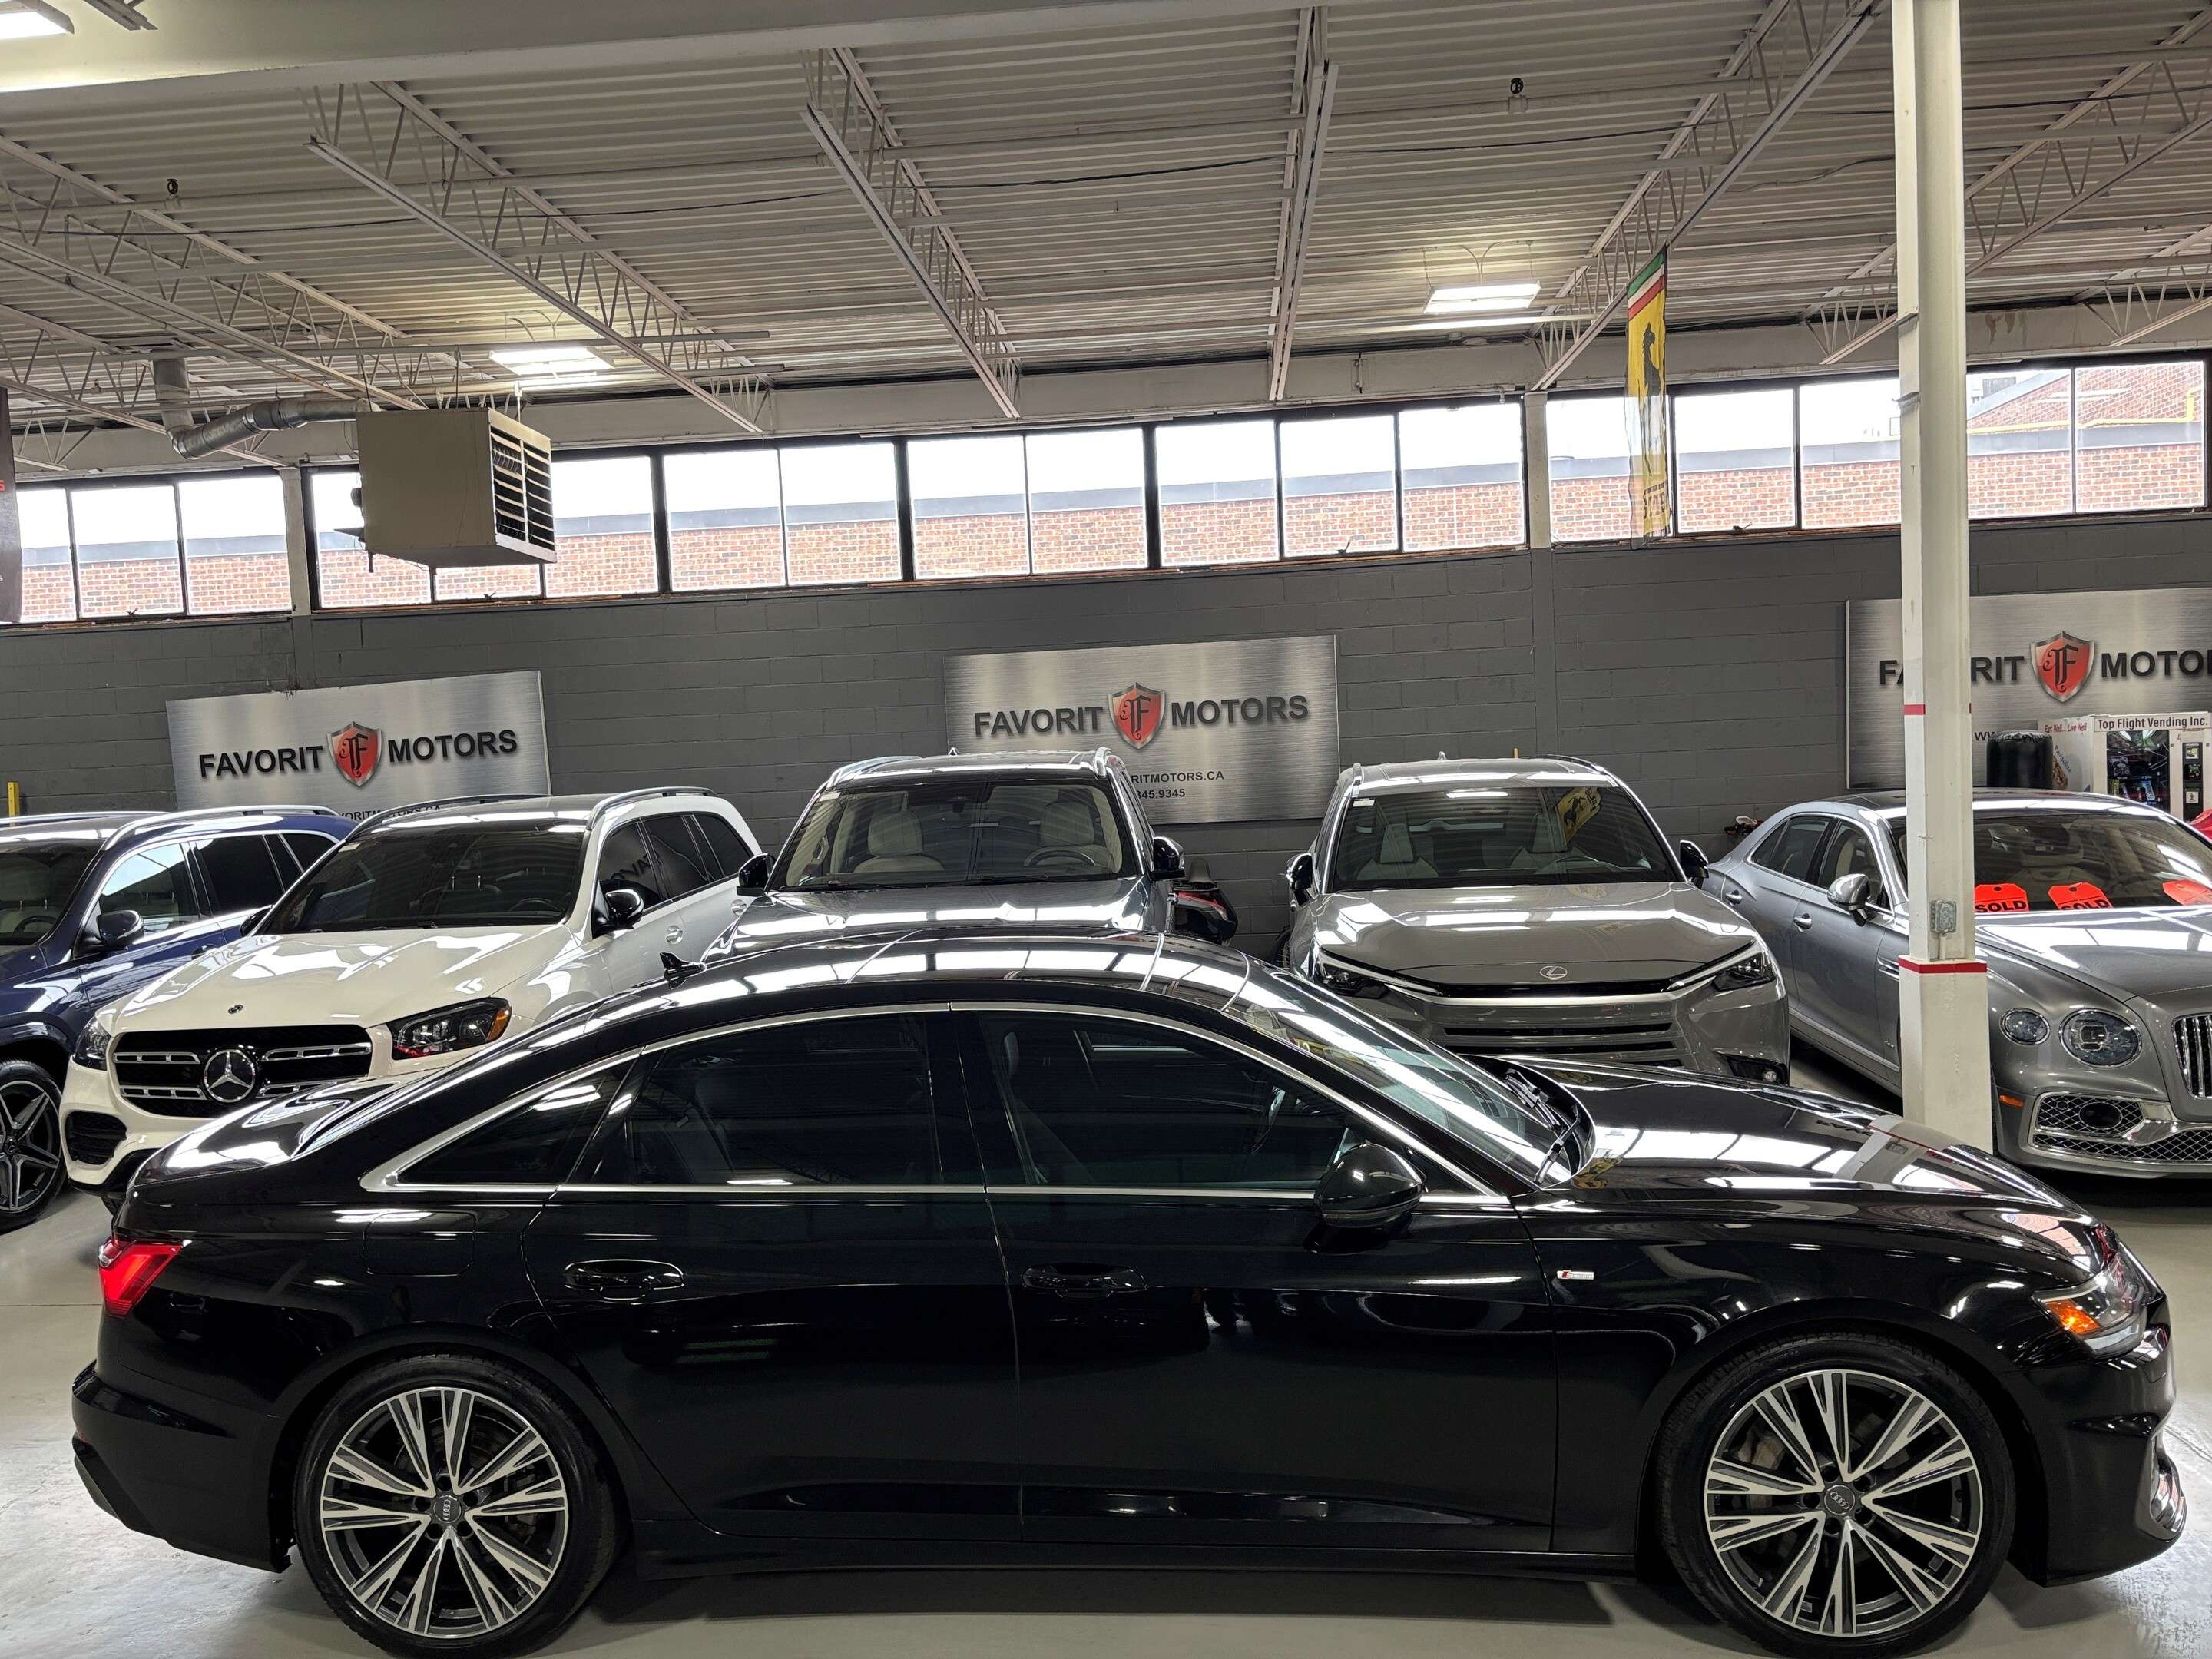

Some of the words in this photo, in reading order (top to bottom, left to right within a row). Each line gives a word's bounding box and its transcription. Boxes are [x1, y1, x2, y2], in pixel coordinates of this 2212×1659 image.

[1880, 656, 2025, 684] FRIT
[2101, 650, 2212, 677] MOTO
[975, 706, 1104, 737] FAVORIT
[1171, 695, 1308, 726] MOTORS
[2078, 722, 2087, 731] Well
[2098, 719, 2114, 730] Top
[2118, 717, 2145, 730] Flight
[2147, 717, 2187, 728] Vending
[2190, 716, 2208, 726] Inc.
[199, 745, 323, 779] FAVORIT
[388, 729, 518, 763] MOTORS
[1975, 900, 2027, 913] SOLD
